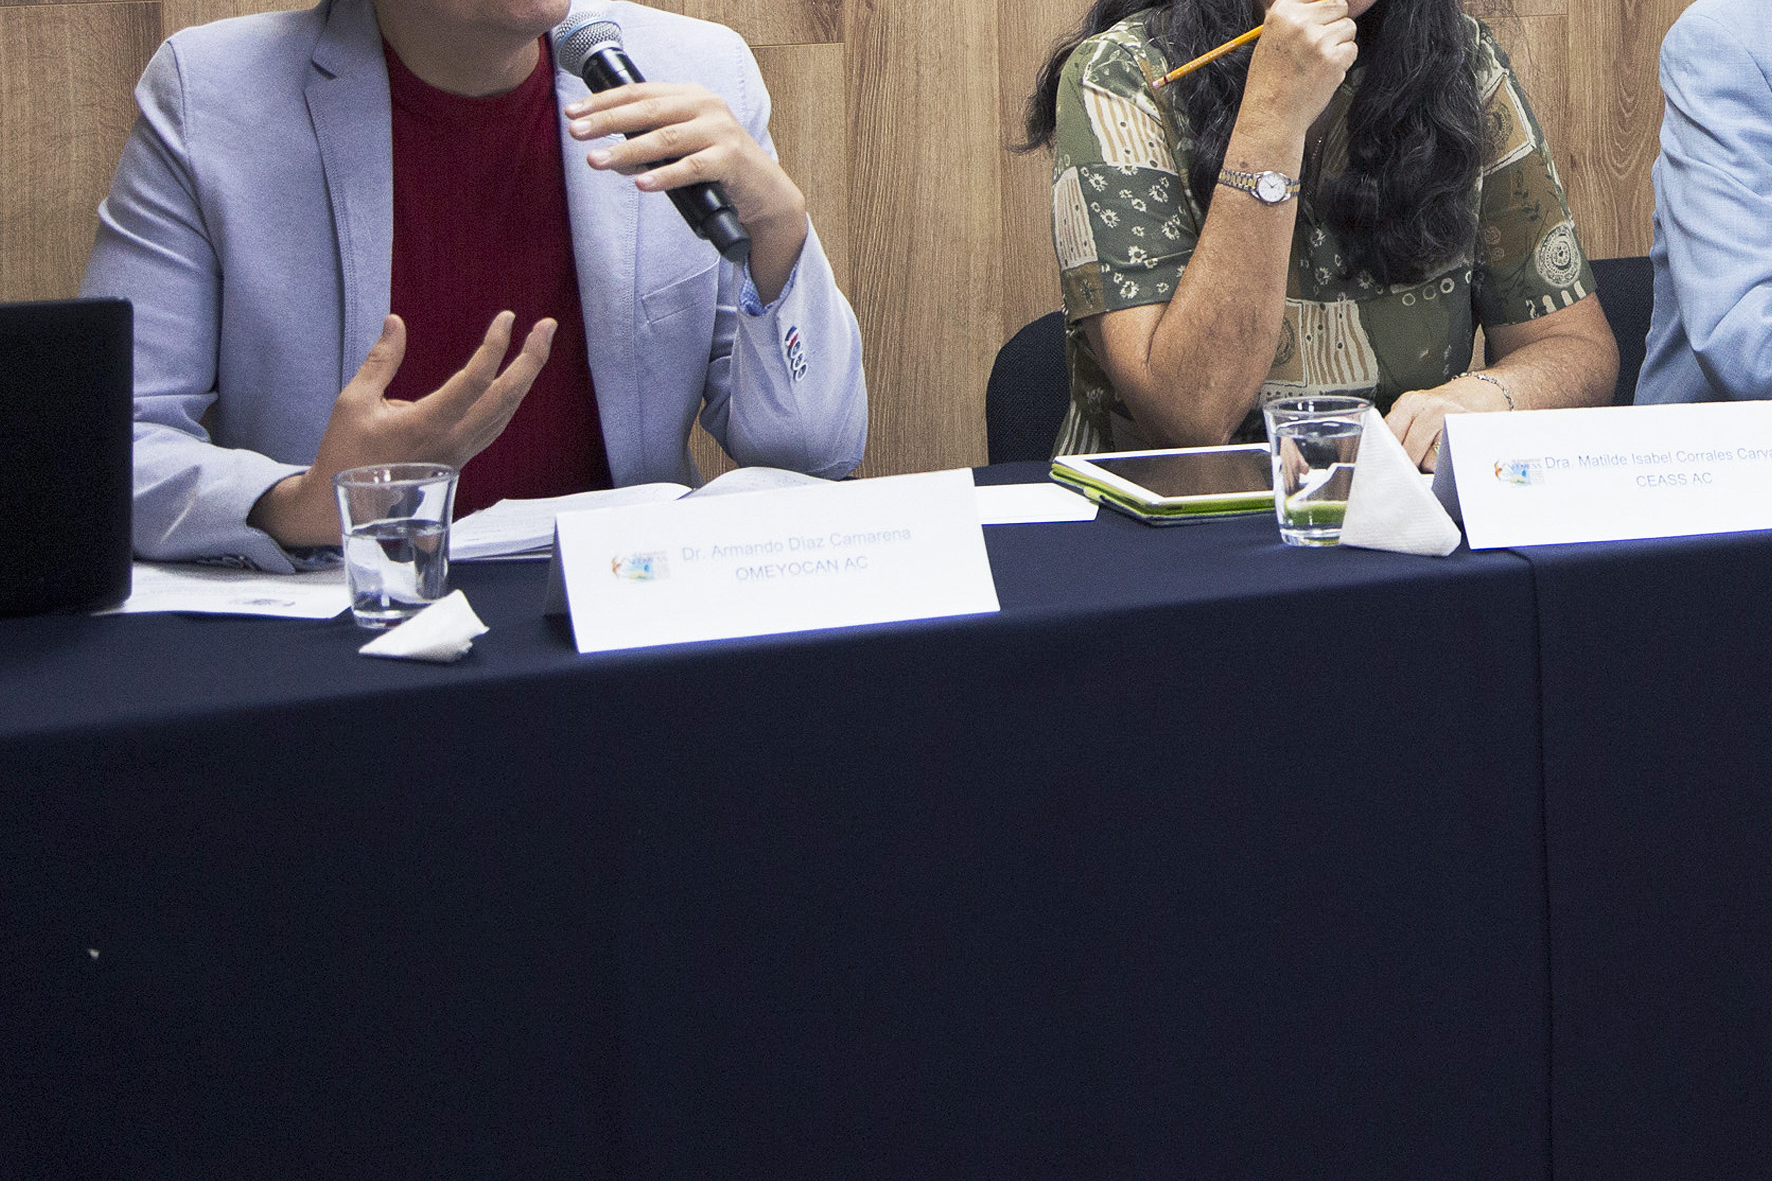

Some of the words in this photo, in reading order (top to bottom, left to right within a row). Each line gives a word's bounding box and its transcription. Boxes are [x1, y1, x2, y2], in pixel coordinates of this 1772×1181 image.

[1544, 456, 1574, 469] Dra.
[1578, 454, 1627, 468] Matilde
[1631, 451, 1672, 465] Isabel
[1676, 450, 1733, 463] Corrales
[1636, 473, 1688, 488] CEASS
[1692, 472, 1713, 485] AC
[681, 547, 705, 562] Dr.
[711, 540, 783, 559] Armando
[829, 529, 911, 547] Camarena
[735, 559, 839, 581] OMEYOCAN
[844, 555, 868, 570] AC
